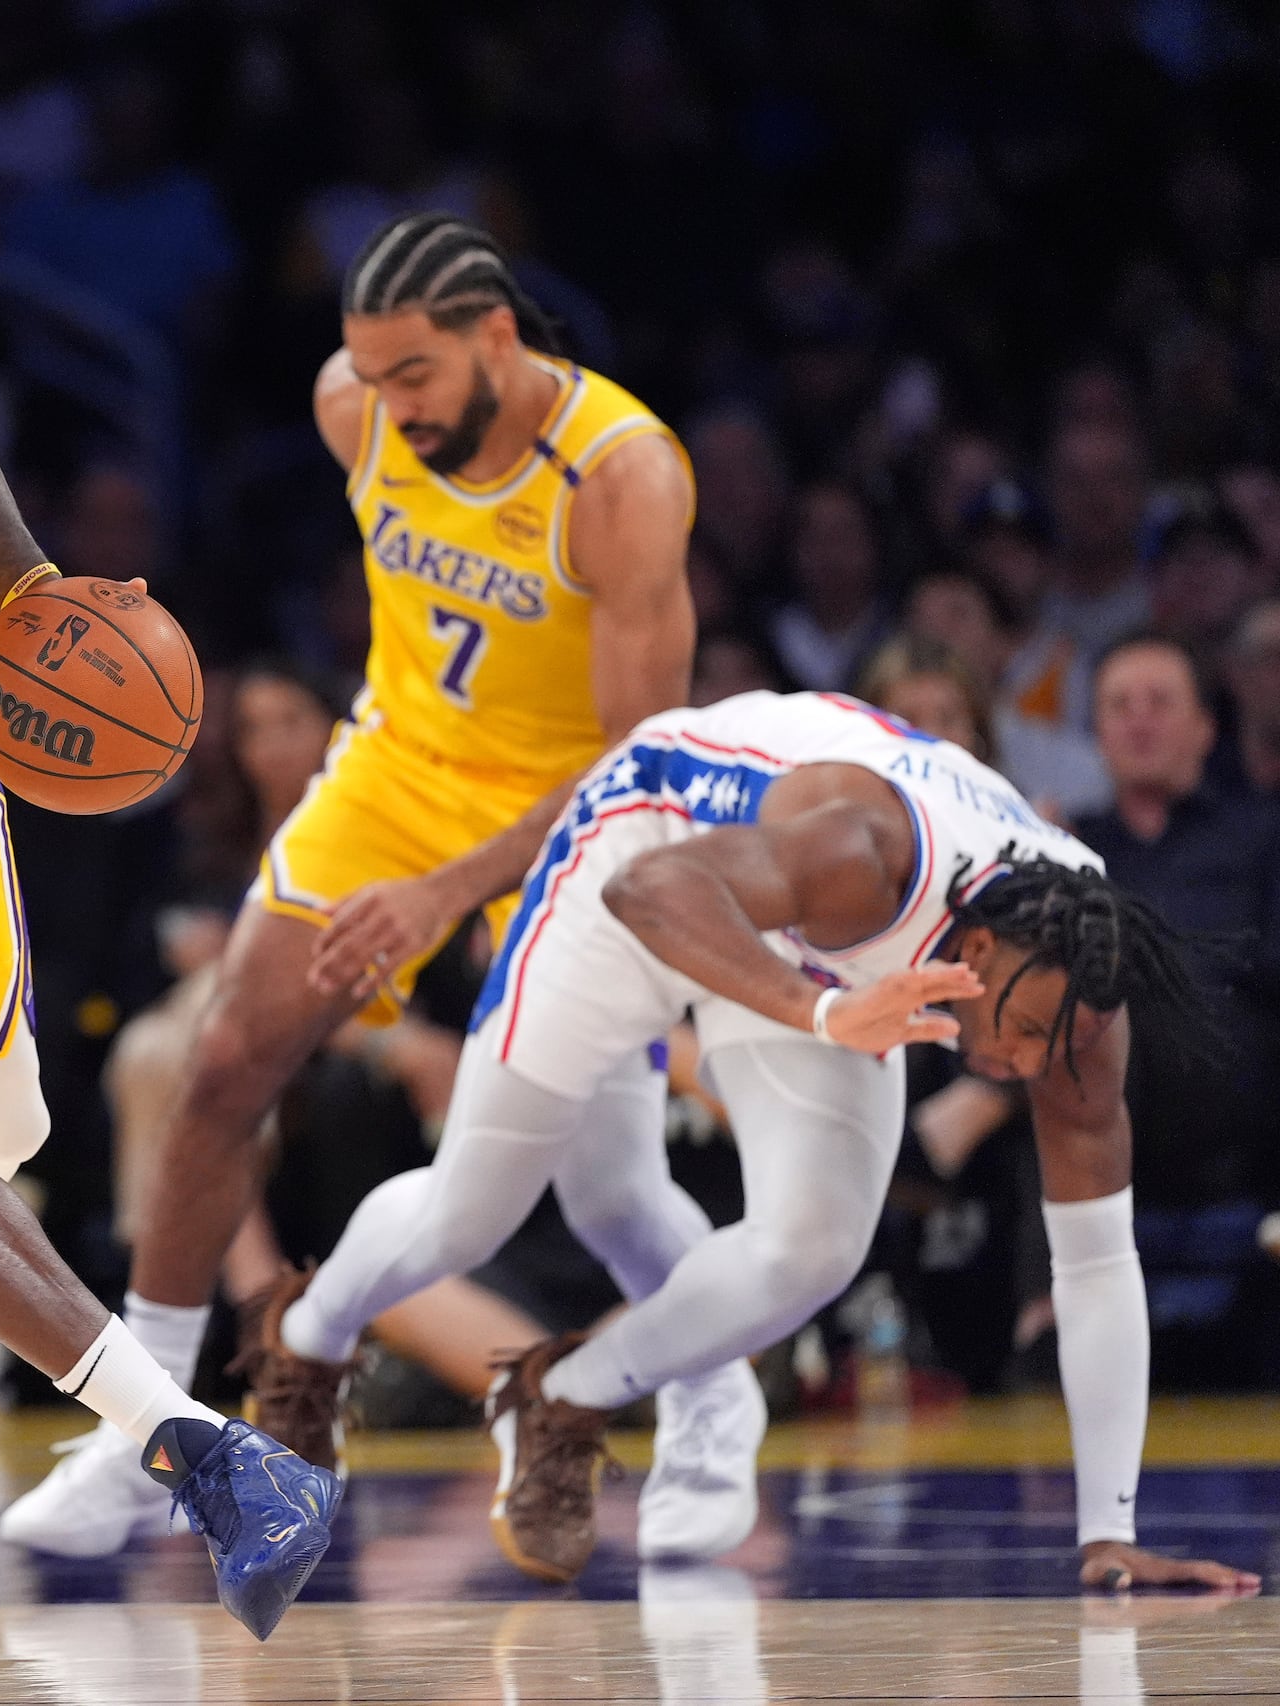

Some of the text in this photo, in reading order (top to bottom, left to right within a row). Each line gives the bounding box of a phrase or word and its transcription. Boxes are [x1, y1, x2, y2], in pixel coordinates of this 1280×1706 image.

[13, 566, 47, 595] PROMISE
[370, 502, 549, 623] LAKERS
[429, 604, 486, 711] 7
